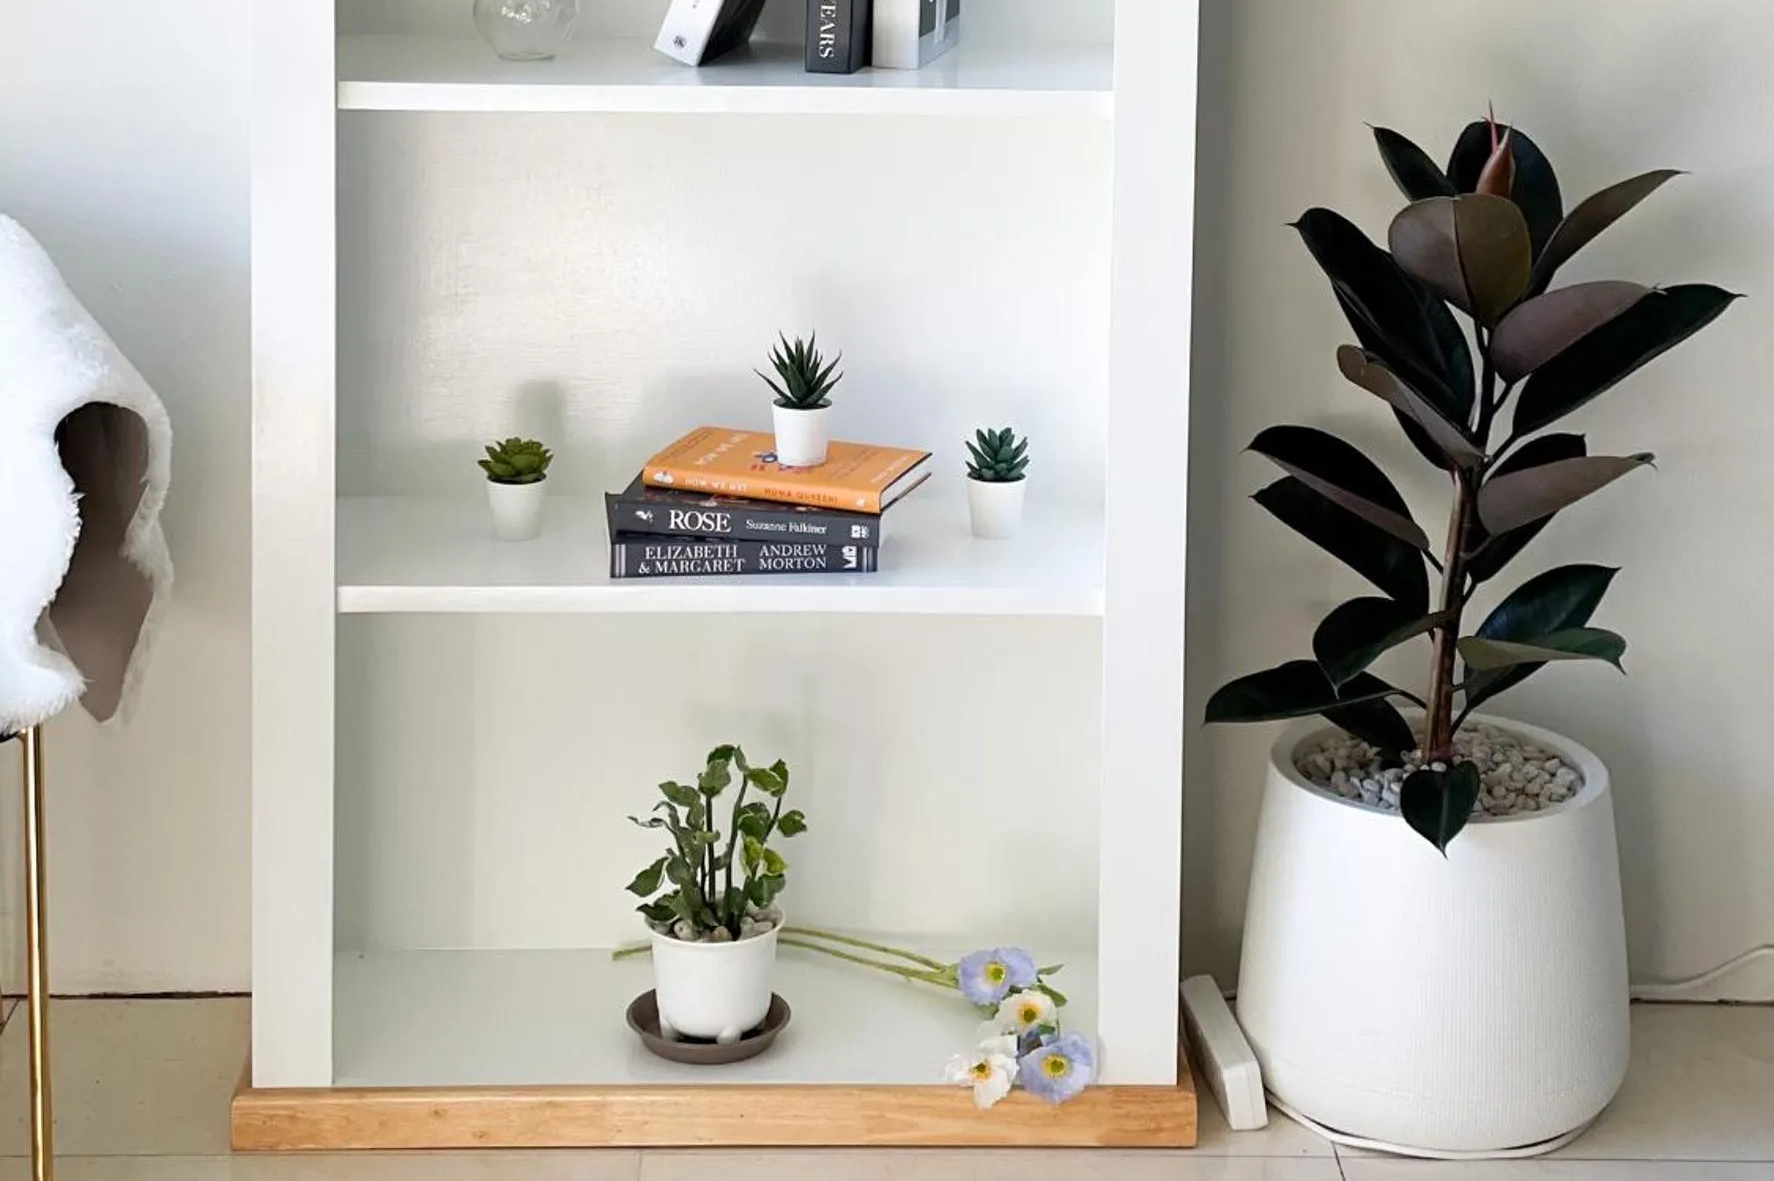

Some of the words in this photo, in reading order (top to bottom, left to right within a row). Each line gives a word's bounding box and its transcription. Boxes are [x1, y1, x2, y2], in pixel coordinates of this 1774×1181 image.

[669, 510, 732, 533] ROSE
[746, 519, 787, 531] Suzanne
[645, 544, 738, 559] ELIZABETH
[759, 544, 827, 557] ANDREW
[638, 562, 650, 574] &
[654, 558, 745, 573] MARGARET
[759, 557, 827, 570] MORTON
